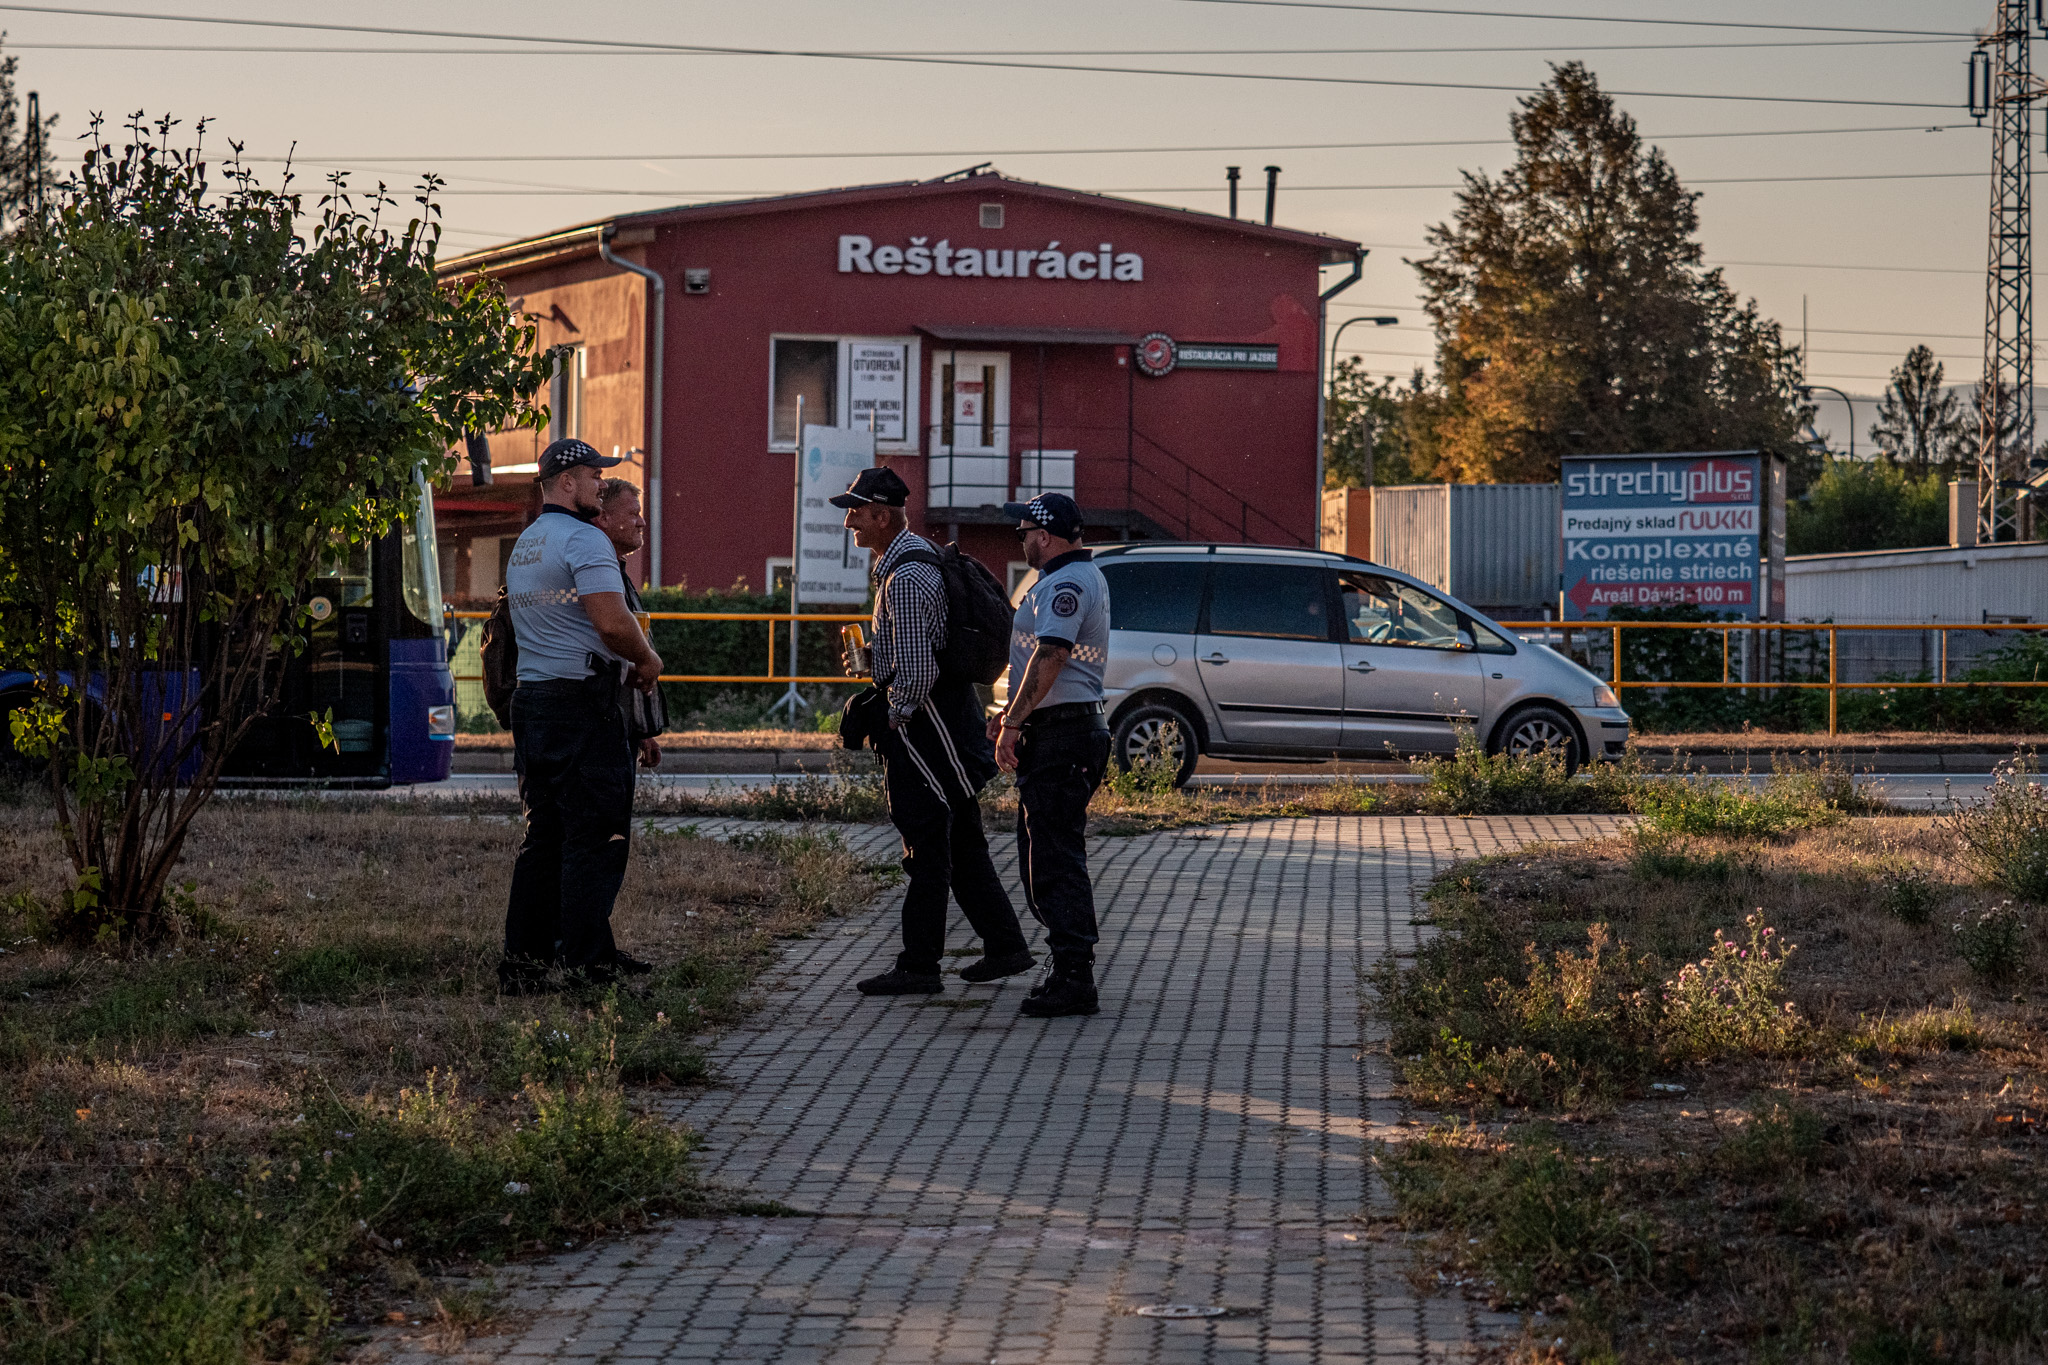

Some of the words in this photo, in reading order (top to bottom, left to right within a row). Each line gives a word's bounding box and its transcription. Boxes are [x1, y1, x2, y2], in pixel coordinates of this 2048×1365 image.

[838, 235, 1143, 281] Reštaurácia
[853, 358, 900, 371] OTVORENÁ
[1233, 351, 1247, 362] PRI
[1568, 516, 1631, 532] Predajný
[1636, 516, 1675, 529] sklad
[515, 534, 547, 549] ESTSKÁ
[510, 549, 542, 566] OLÍCIA
[1567, 537, 1752, 564] Komplexné
[1591, 563, 1673, 581] riešenie
[1680, 562, 1752, 580] striech
[1591, 588, 1633, 603] Areál
[1695, 586, 1723, 602] 100
[1728, 589, 1743, 602] m
